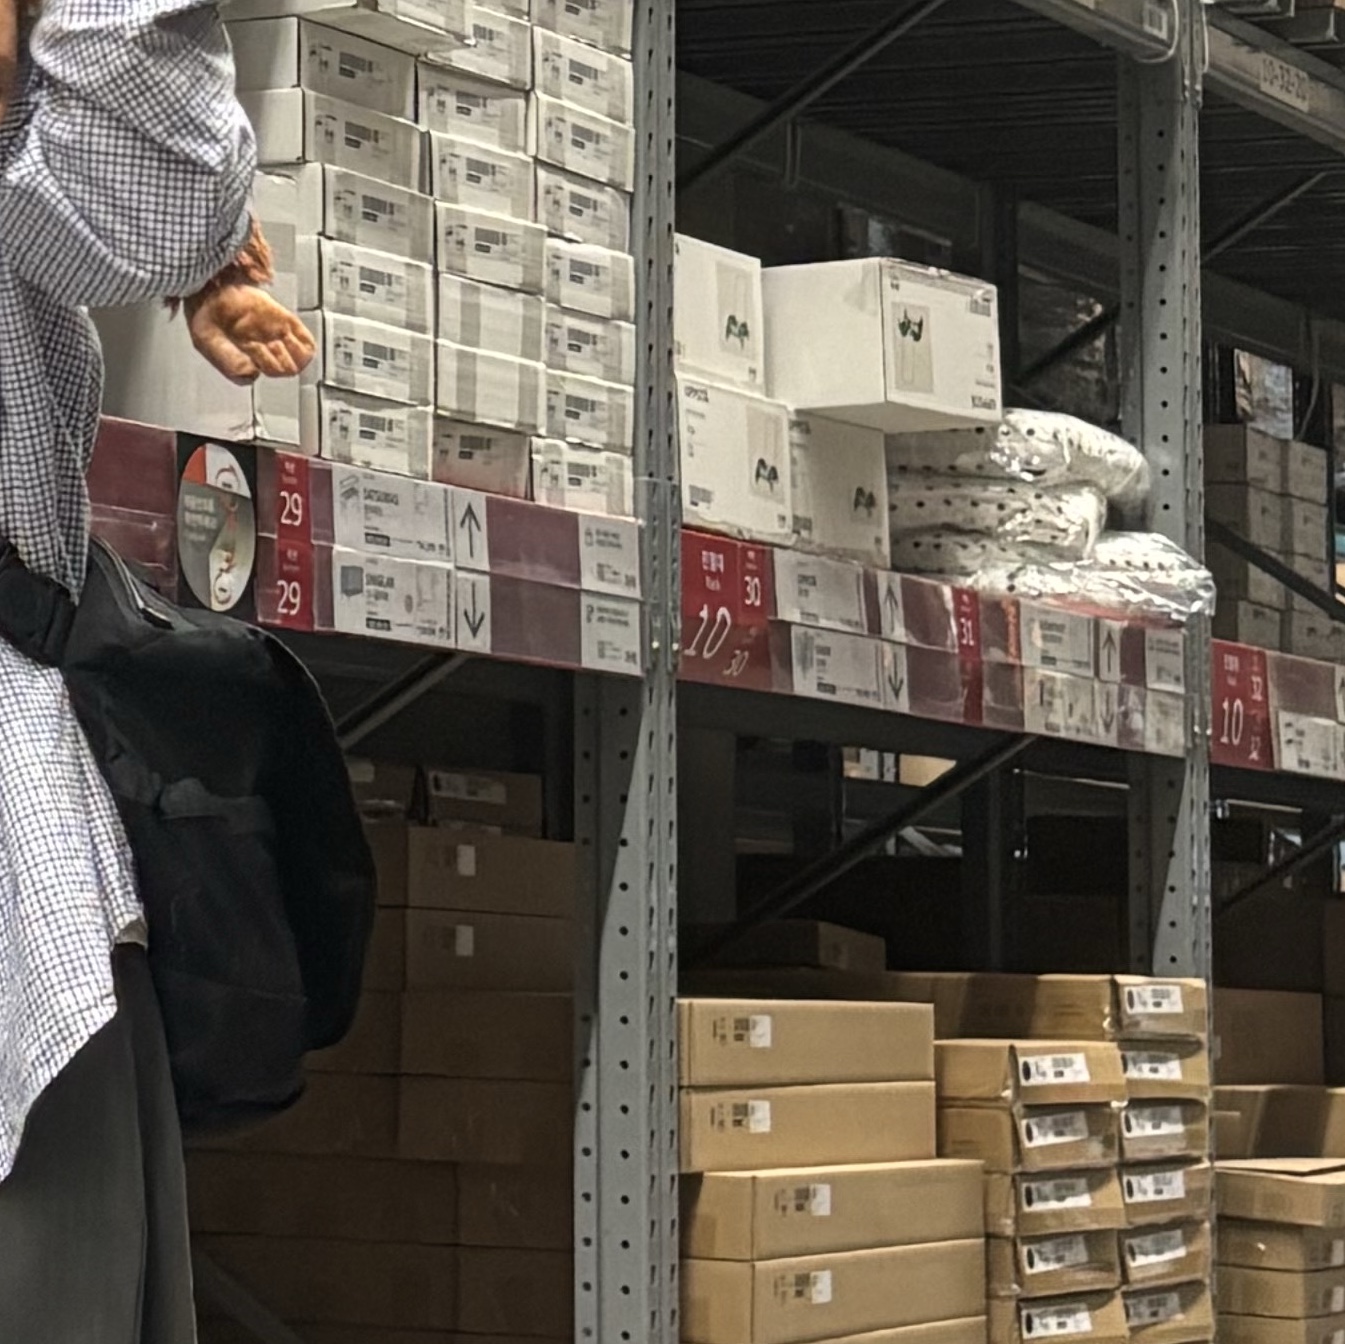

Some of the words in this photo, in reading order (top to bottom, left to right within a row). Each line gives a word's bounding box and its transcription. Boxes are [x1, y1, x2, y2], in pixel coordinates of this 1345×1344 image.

[279, 491, 303, 526] 29
[276, 580, 301, 615] 29
[744, 575, 761, 606] 30
[684, 604, 732, 659] 10
[960, 617, 975, 647] 31
[1220, 697, 1244, 745] 10
